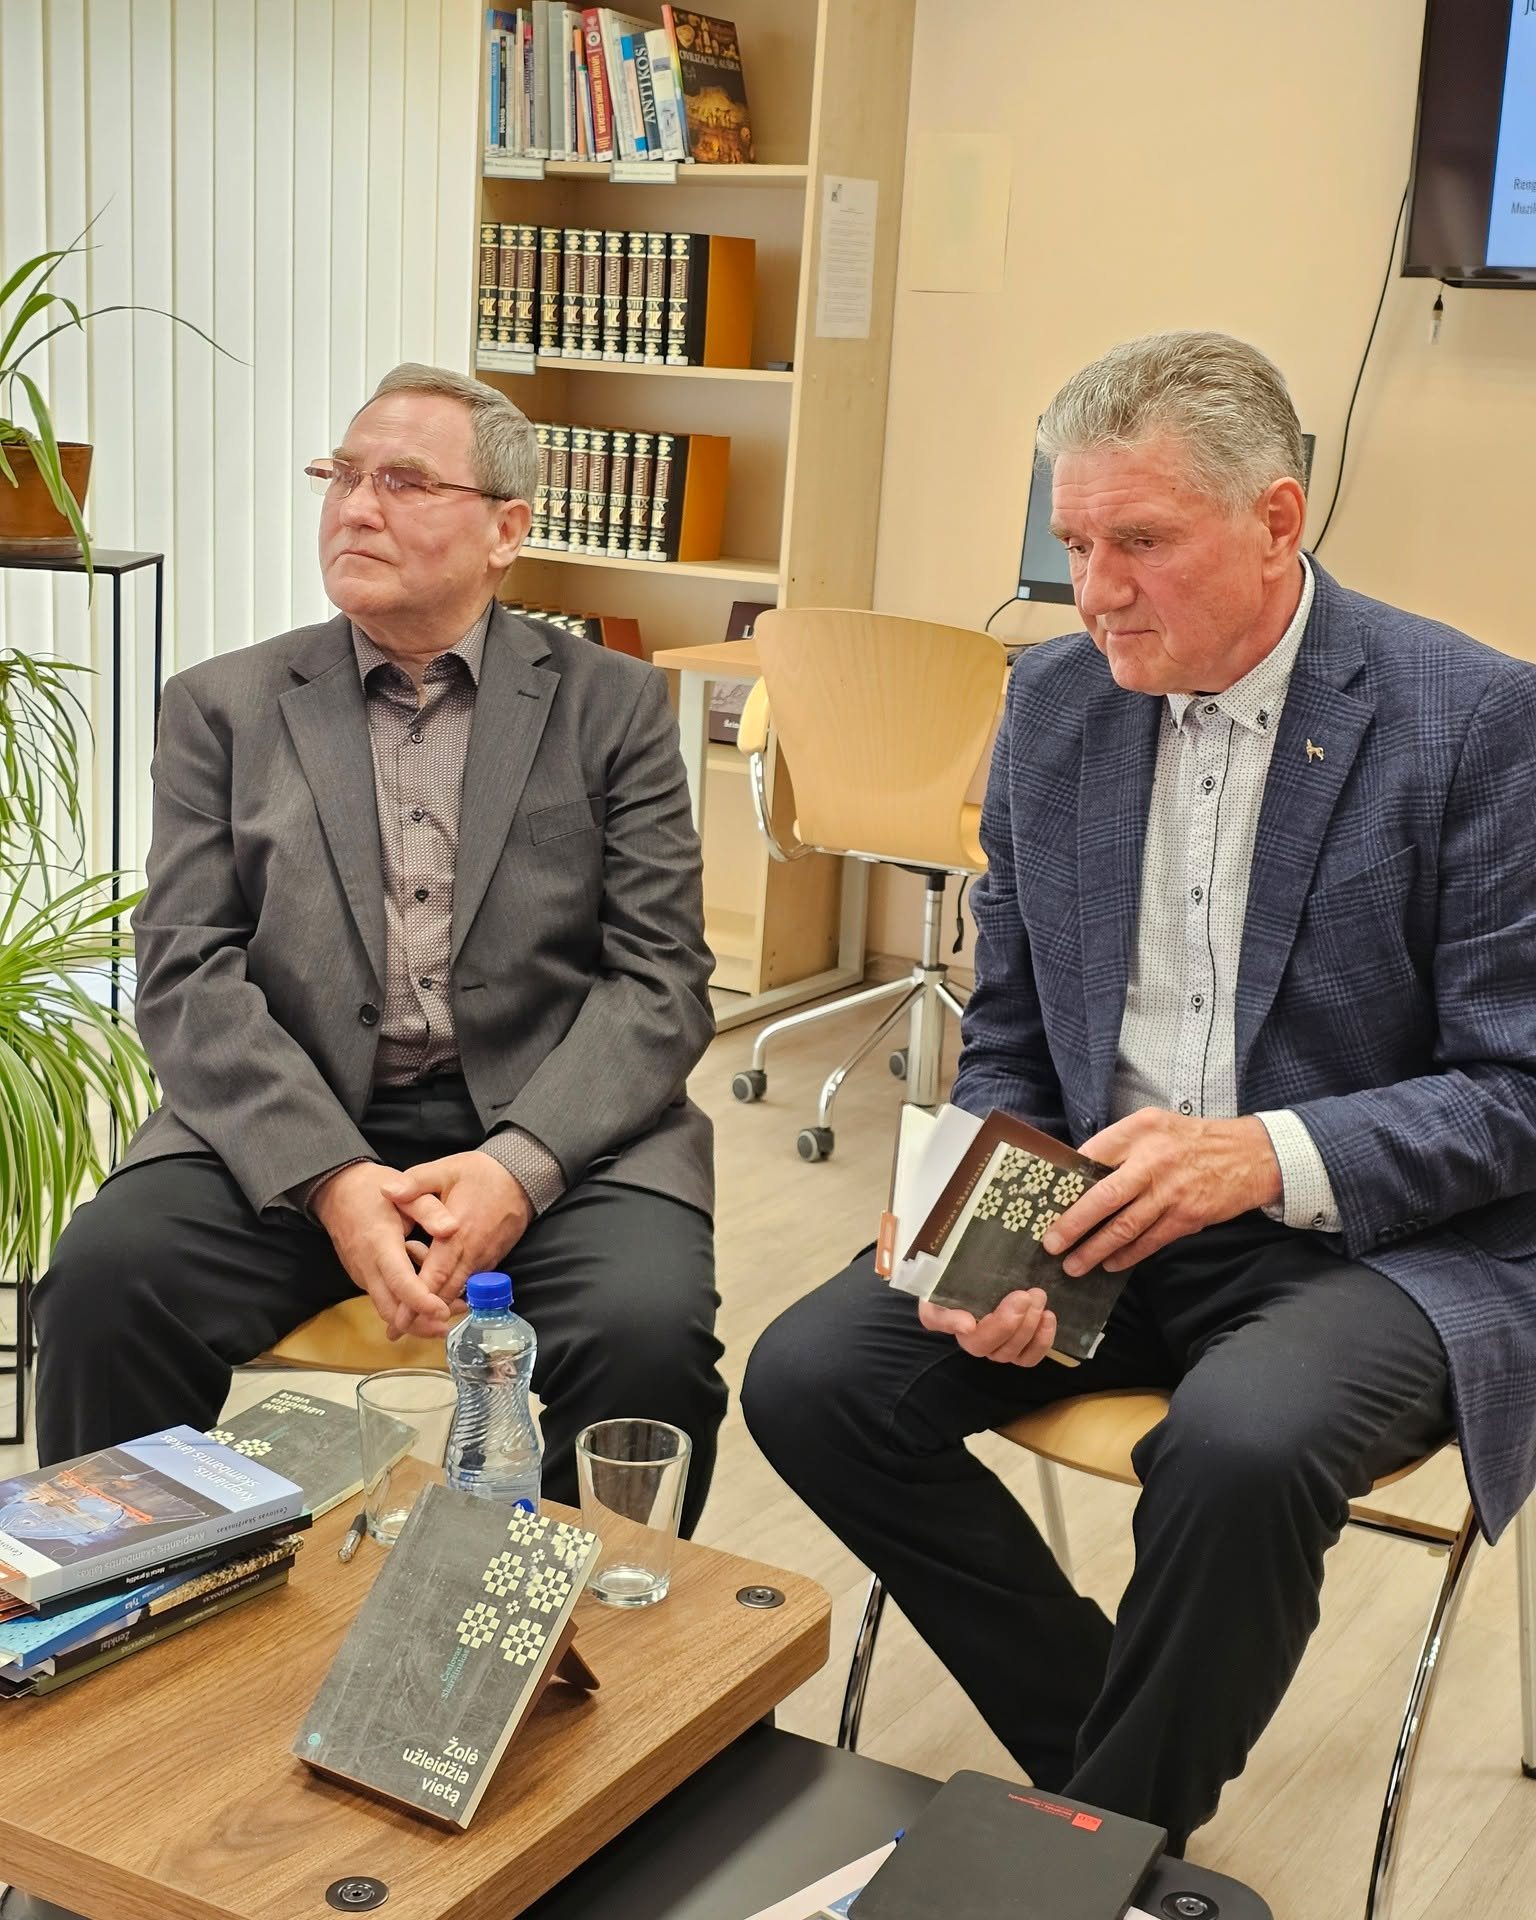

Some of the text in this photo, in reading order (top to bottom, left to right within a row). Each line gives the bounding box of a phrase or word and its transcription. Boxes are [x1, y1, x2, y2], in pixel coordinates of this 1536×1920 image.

[635, 47, 656, 123] ANTIKOS
[160, 1434, 262, 1487] skambantis laikas
[125, 1597, 140, 1610] Tyka
[100, 1630, 131, 1652] Ženklai
[403, 1747, 470, 1785] užleidžia
[443, 1737, 480, 1765] Žolė
[422, 1777, 461, 1808] vietą
